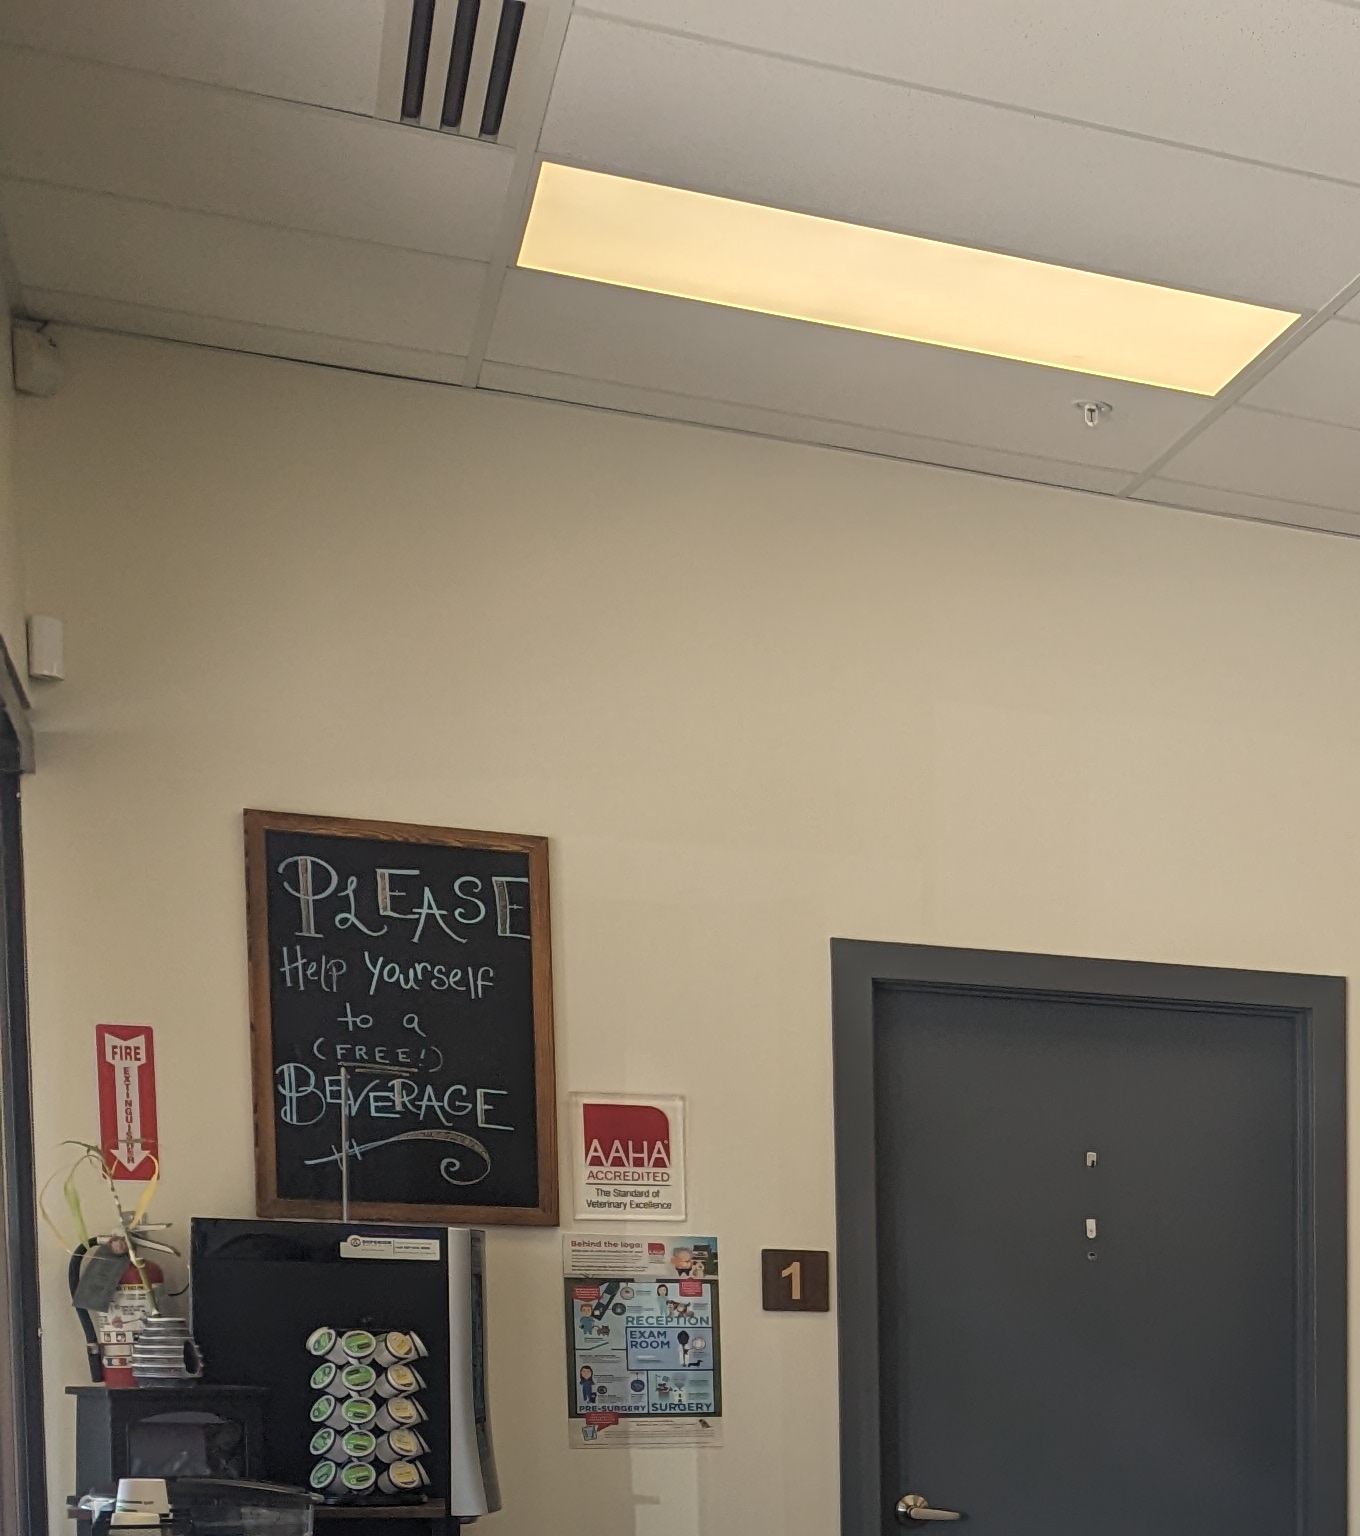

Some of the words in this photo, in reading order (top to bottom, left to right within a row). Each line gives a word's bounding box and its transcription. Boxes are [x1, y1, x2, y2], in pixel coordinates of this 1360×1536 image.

[277, 855, 531, 943] PLEASE
[279, 945, 347, 993] Help
[337, 1002, 373, 1031] to
[403, 1013, 427, 1038] a
[111, 1044, 142, 1062] FIRE
[275, 1062, 516, 1132] BEVERAGE
[585, 1138, 671, 1168] AAHA
[586, 1170, 671, 1182] ACCREDITED
[595, 1187, 611, 1198] The
[612, 1188, 650, 1198] Standard
[651, 1189, 661, 1198] of
[586, 1199, 627, 1210] Veterinary
[629, 1200, 672, 1210] Excellence
[571, 1240, 602, 1248] Behind
[603, 1240, 618, 1248] the
[781, 1261, 801, 1300] 1
[625, 1315, 710, 1326] RECEPTION
[629, 1330, 667, 1340] EXAM
[630, 1340, 671, 1350] ROOM
[579, 1404, 647, 1412] PRE-SURGERY
[651, 1402, 713, 1413] SURGERY
